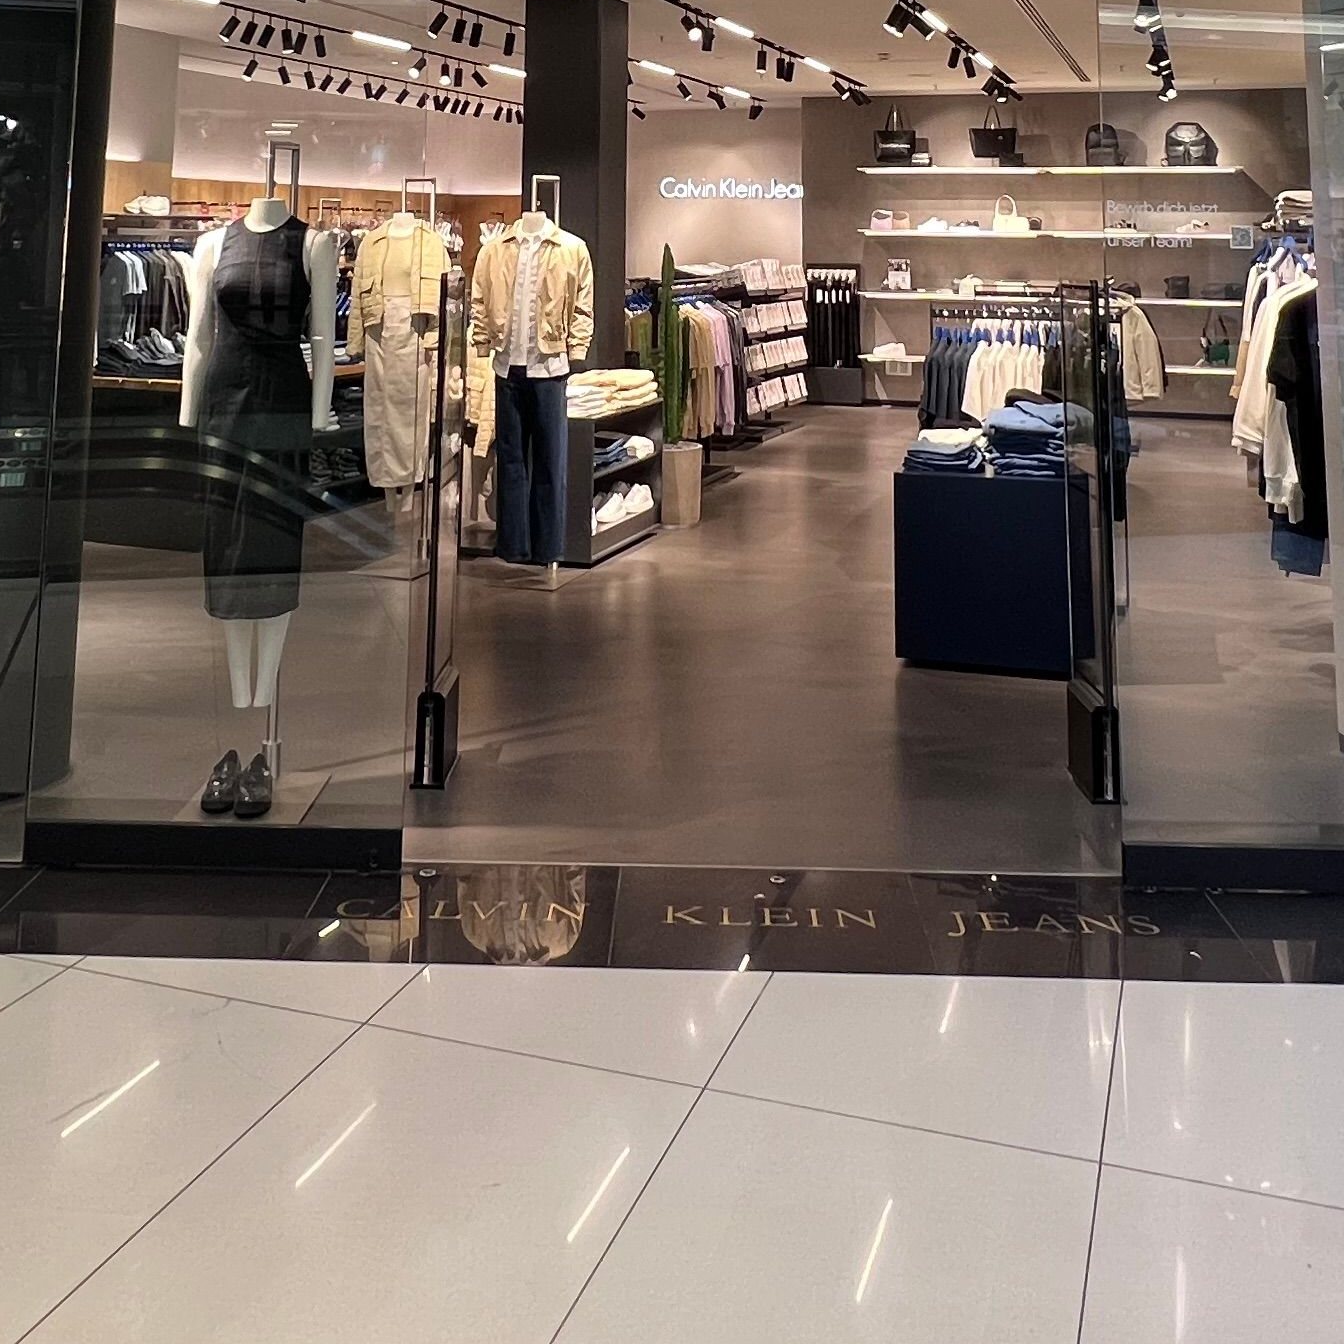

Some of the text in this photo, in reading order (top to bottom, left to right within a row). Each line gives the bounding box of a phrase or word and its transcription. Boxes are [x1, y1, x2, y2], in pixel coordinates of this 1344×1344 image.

[659, 176, 717, 199] Calvin
[719, 177, 763, 199] Klein
[336, 898, 1161, 938] CALVIN KLEIN JEANS
